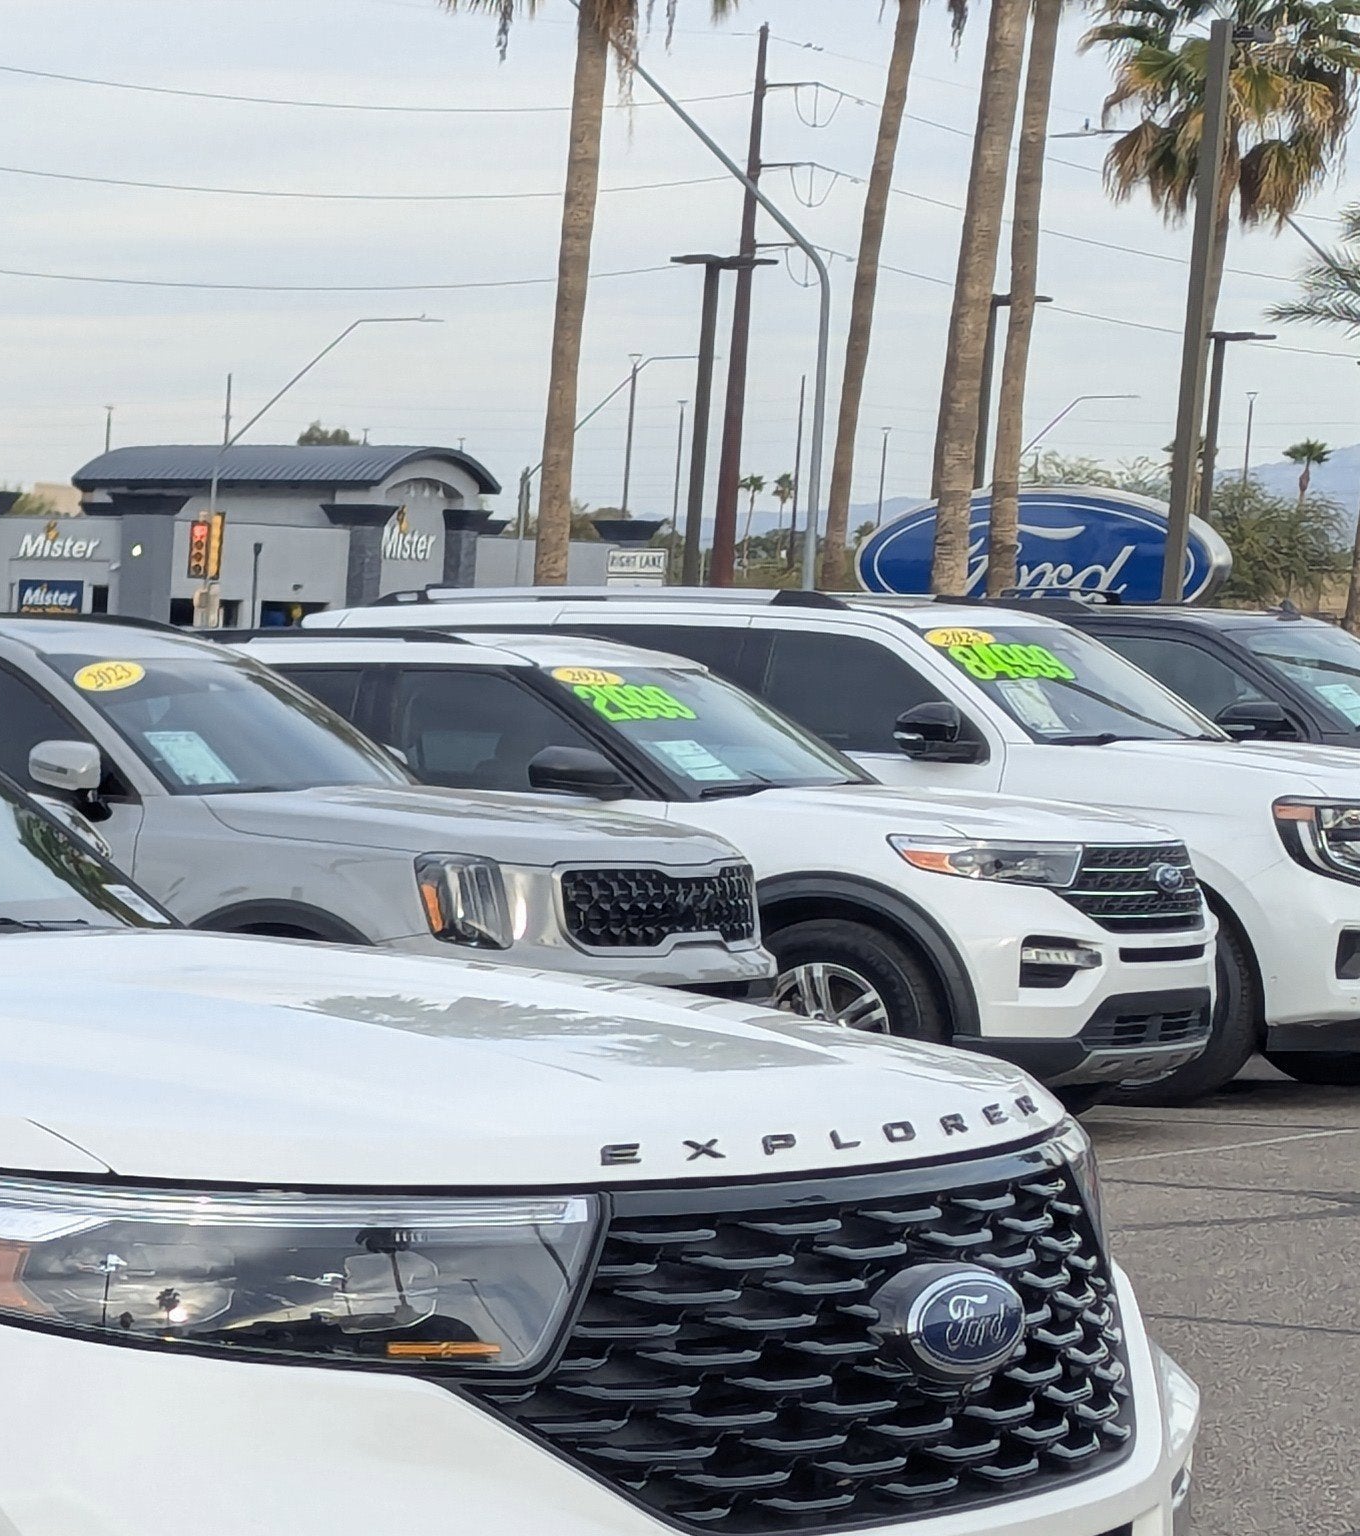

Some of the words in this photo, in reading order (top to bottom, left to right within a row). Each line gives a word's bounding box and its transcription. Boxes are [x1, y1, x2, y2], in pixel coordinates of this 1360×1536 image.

[17, 532, 101, 558] Mister
[381, 523, 436, 561] Mister
[21, 586, 78, 606] Mister
[86, 663, 132, 689] 2023
[948, 642, 1077, 681] 84999
[573, 684, 698, 722] 21999
[600, 1094, 1039, 1166] EXPLORER
[946, 1293, 1008, 1352] Ford
